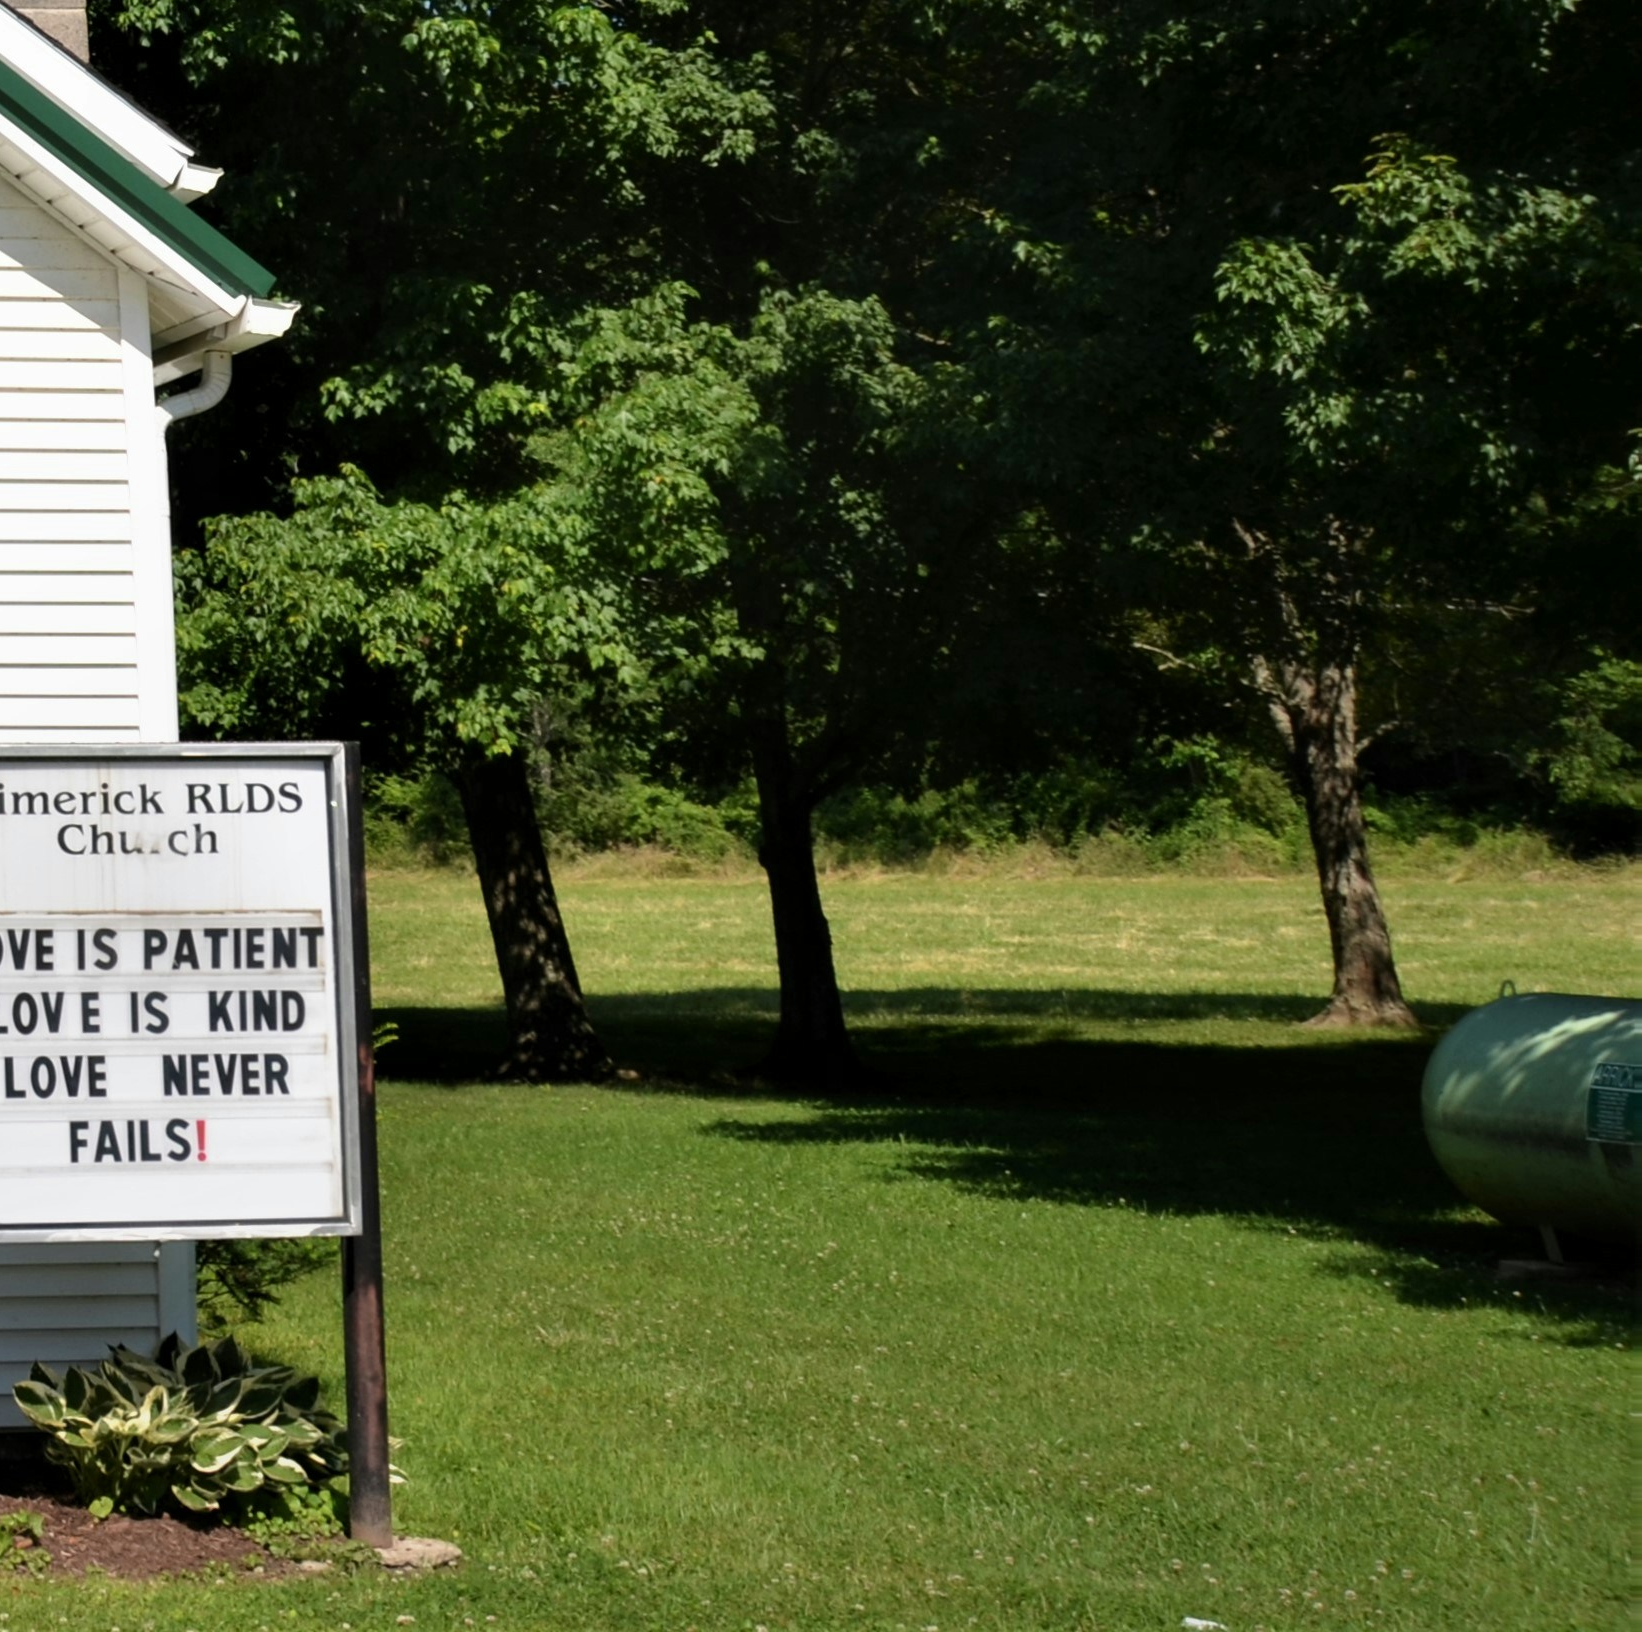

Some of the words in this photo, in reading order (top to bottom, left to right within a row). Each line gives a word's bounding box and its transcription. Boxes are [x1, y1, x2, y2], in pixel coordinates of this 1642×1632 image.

[186, 782, 303, 814] RLDS
[56, 823, 219, 856] Chuch
[76, 928, 119, 970] IS
[143, 926, 325, 970] PATIENT
[130, 991, 170, 1034] IS
[208, 990, 306, 1033] KIND
[4, 1055, 108, 1100] LOVE
[162, 1053, 290, 1096] NEVER
[69, 1118, 208, 1164] FAILS!
